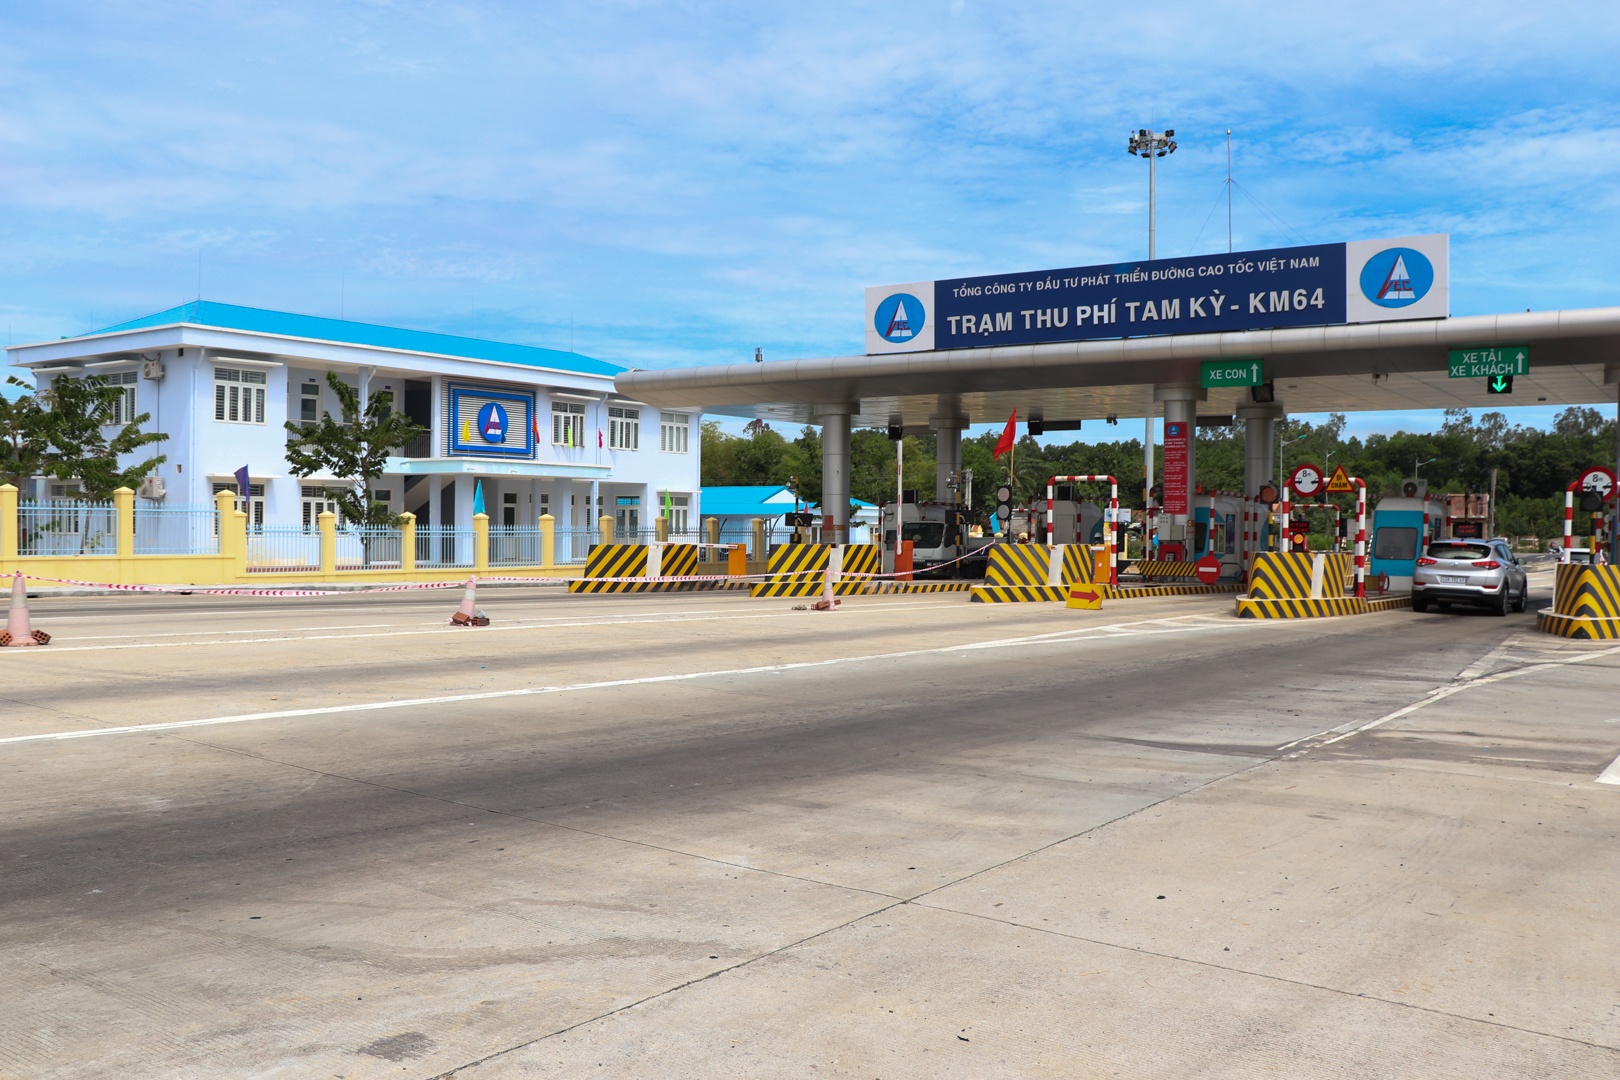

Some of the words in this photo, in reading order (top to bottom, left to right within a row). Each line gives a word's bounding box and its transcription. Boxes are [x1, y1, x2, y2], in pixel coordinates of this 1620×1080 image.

[953, 282, 982, 298] TỔNG
[985, 282, 1016, 295] CÔNG
[1019, 282, 1033, 292] TY
[1036, 276, 1060, 291] ĐẦU
[1063, 276, 1079, 288] TƯ
[1081, 273, 1110, 287] PHÁT
[1114, 267, 1149, 284] TRIỂN
[1151, 267, 1195, 281] ĐƯỜNG
[1198, 264, 1224, 277] CAO
[1228, 258, 1254, 274] TỐC
[1257, 257, 1287, 273] VIỆT
[1290, 256, 1320, 269] NAM
[947, 311, 1013, 336] TRẠM
[1020, 307, 1069, 330] THU
[1076, 298, 1118, 326] PHÍ
[1125, 298, 1180, 323] TAM
[1189, 289, 1226, 318] KỲ
[1249, 287, 1325, 314] KM64
[1462, 352, 1478, 364] XE
[1480, 348, 1502, 363] TẢI
[1209, 369, 1223, 380] XE
[1225, 368, 1247, 379] CON
[1450, 365, 1466, 377] XE
[1471, 361, 1514, 376] KHÁCH
